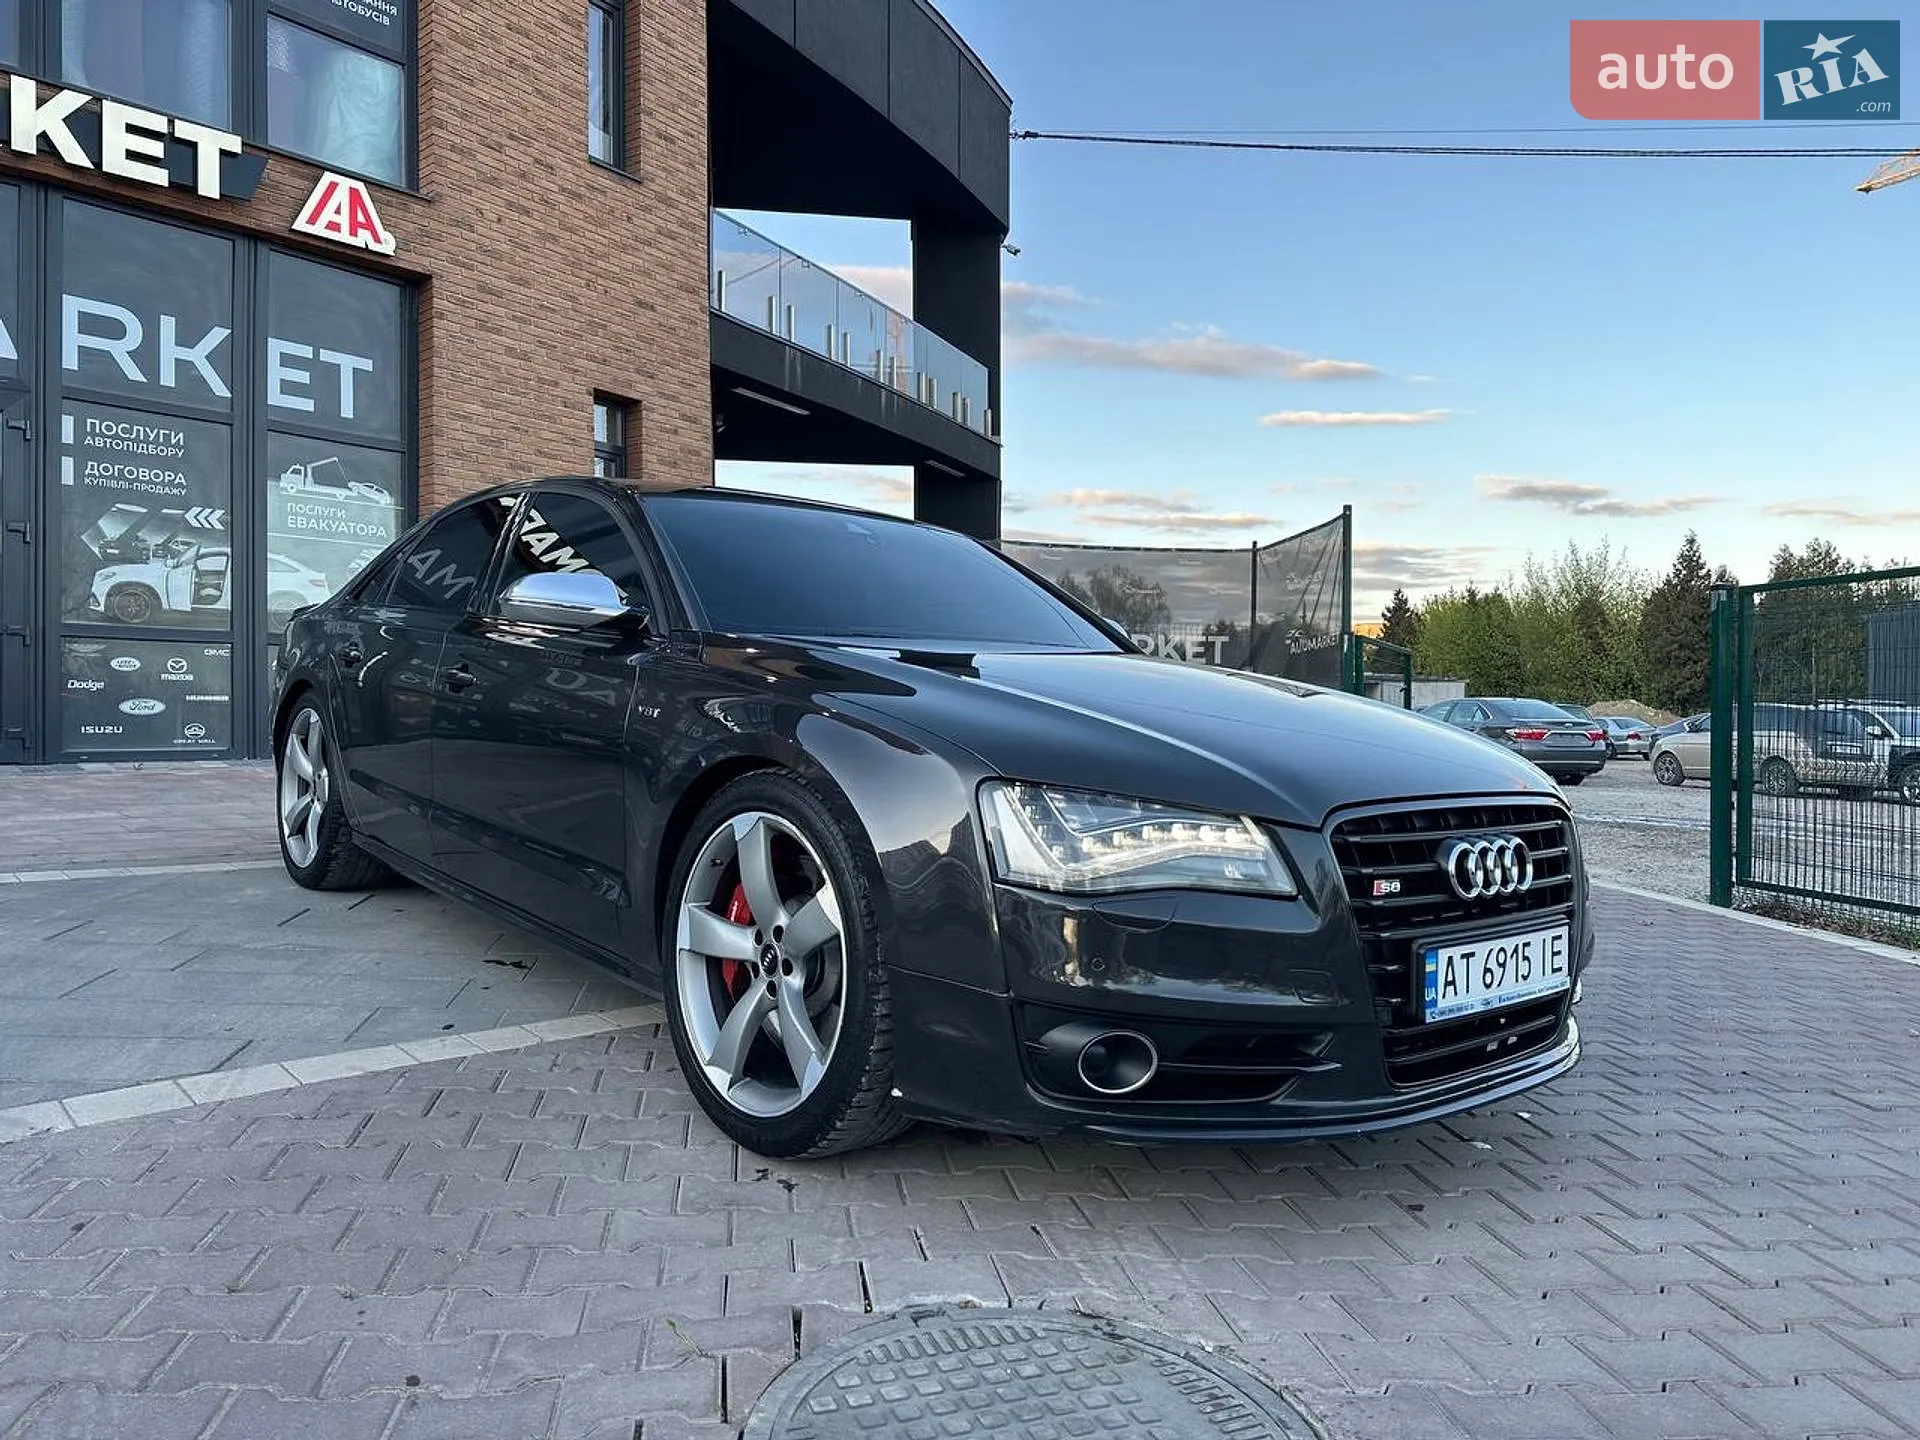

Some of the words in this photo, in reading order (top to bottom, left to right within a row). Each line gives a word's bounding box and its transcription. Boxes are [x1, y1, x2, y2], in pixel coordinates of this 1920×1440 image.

[86, 418, 184, 446] ПОСЛУГИ
[84, 436, 184, 458] АВТОПІДБОРУ
[85, 461, 187, 486] ДОГОВОРА
[84, 476, 187, 496] КУПІВЛІ-ПРОДАЖУ
[287, 503, 346, 519] ПОСЛУГИ
[287, 515, 388, 538] ЕВАКУАТОРА
[67, 679, 105, 691] Dodge
[81, 725, 123, 734] ISUZU
[1442, 951, 1475, 999] AT
[1482, 941, 1531, 990] 6915
[1542, 934, 1562, 975] IE
